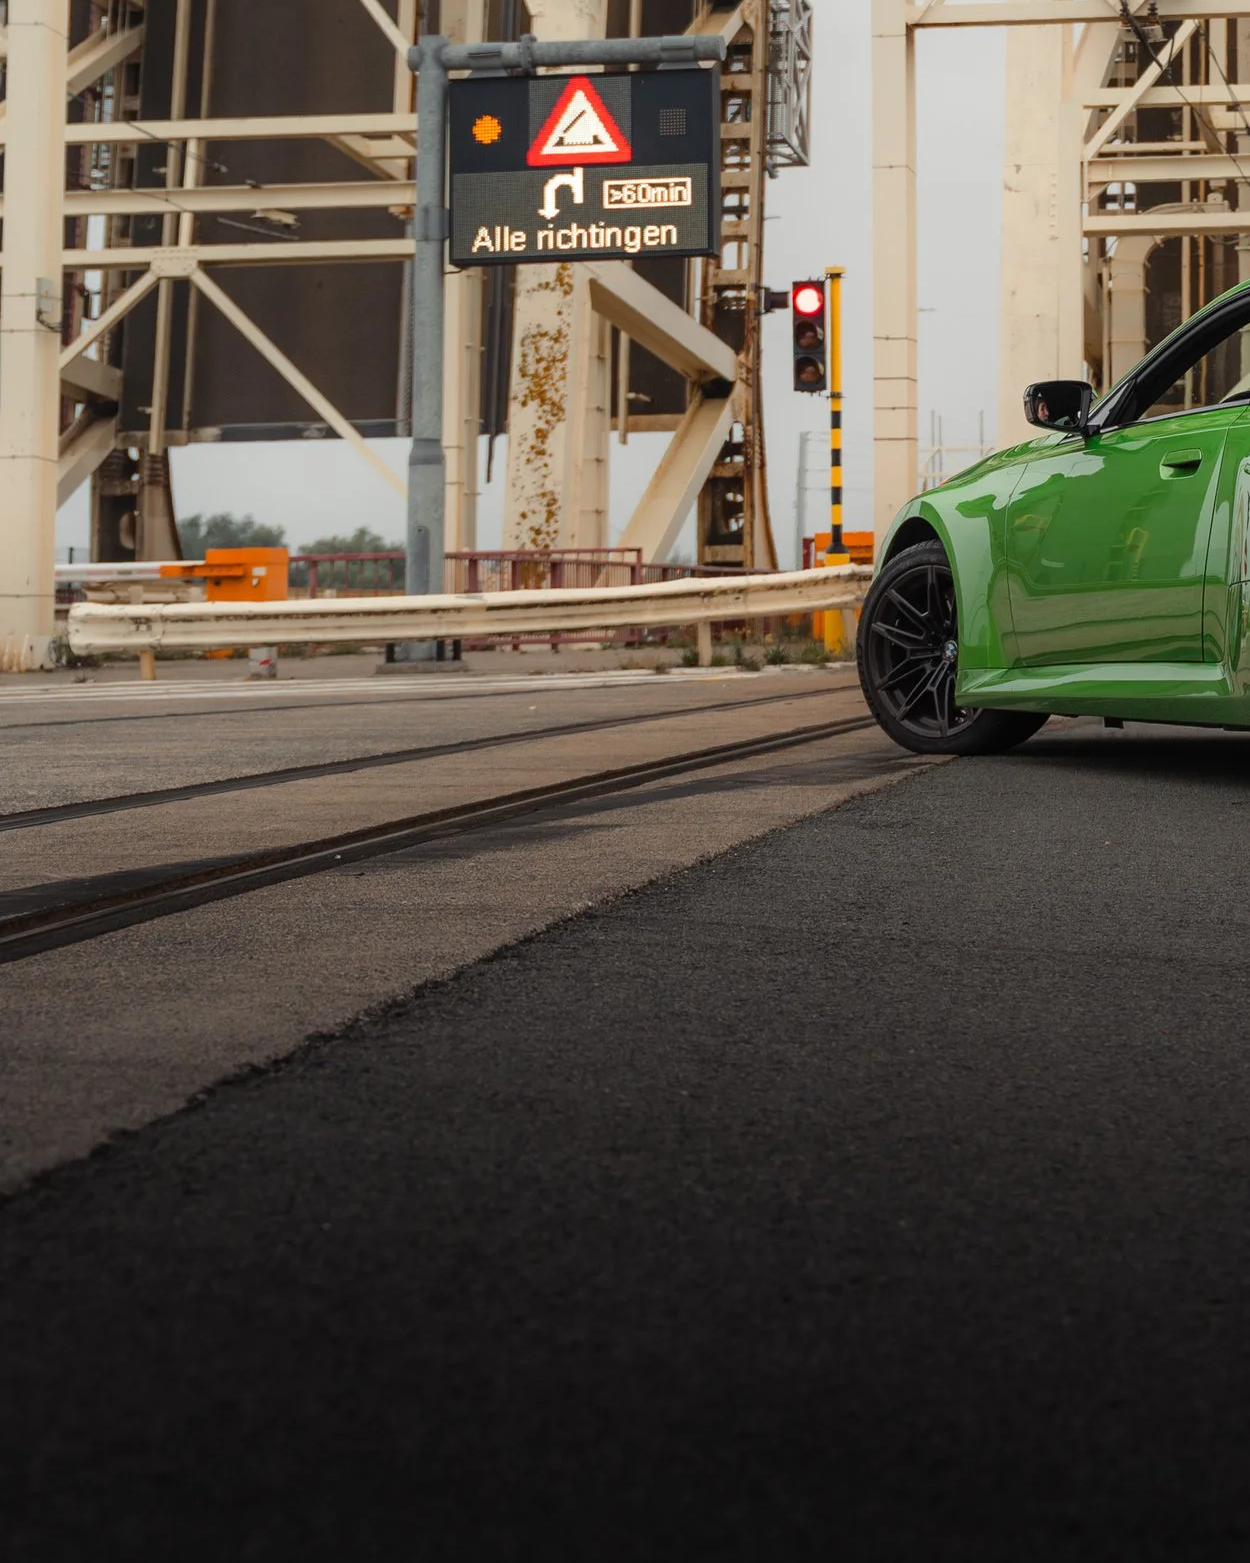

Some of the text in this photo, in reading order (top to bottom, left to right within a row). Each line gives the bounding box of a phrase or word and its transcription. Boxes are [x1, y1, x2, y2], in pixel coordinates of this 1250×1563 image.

[609, 183, 688, 204] >60min
[471, 221, 678, 253] Alle richtingen
